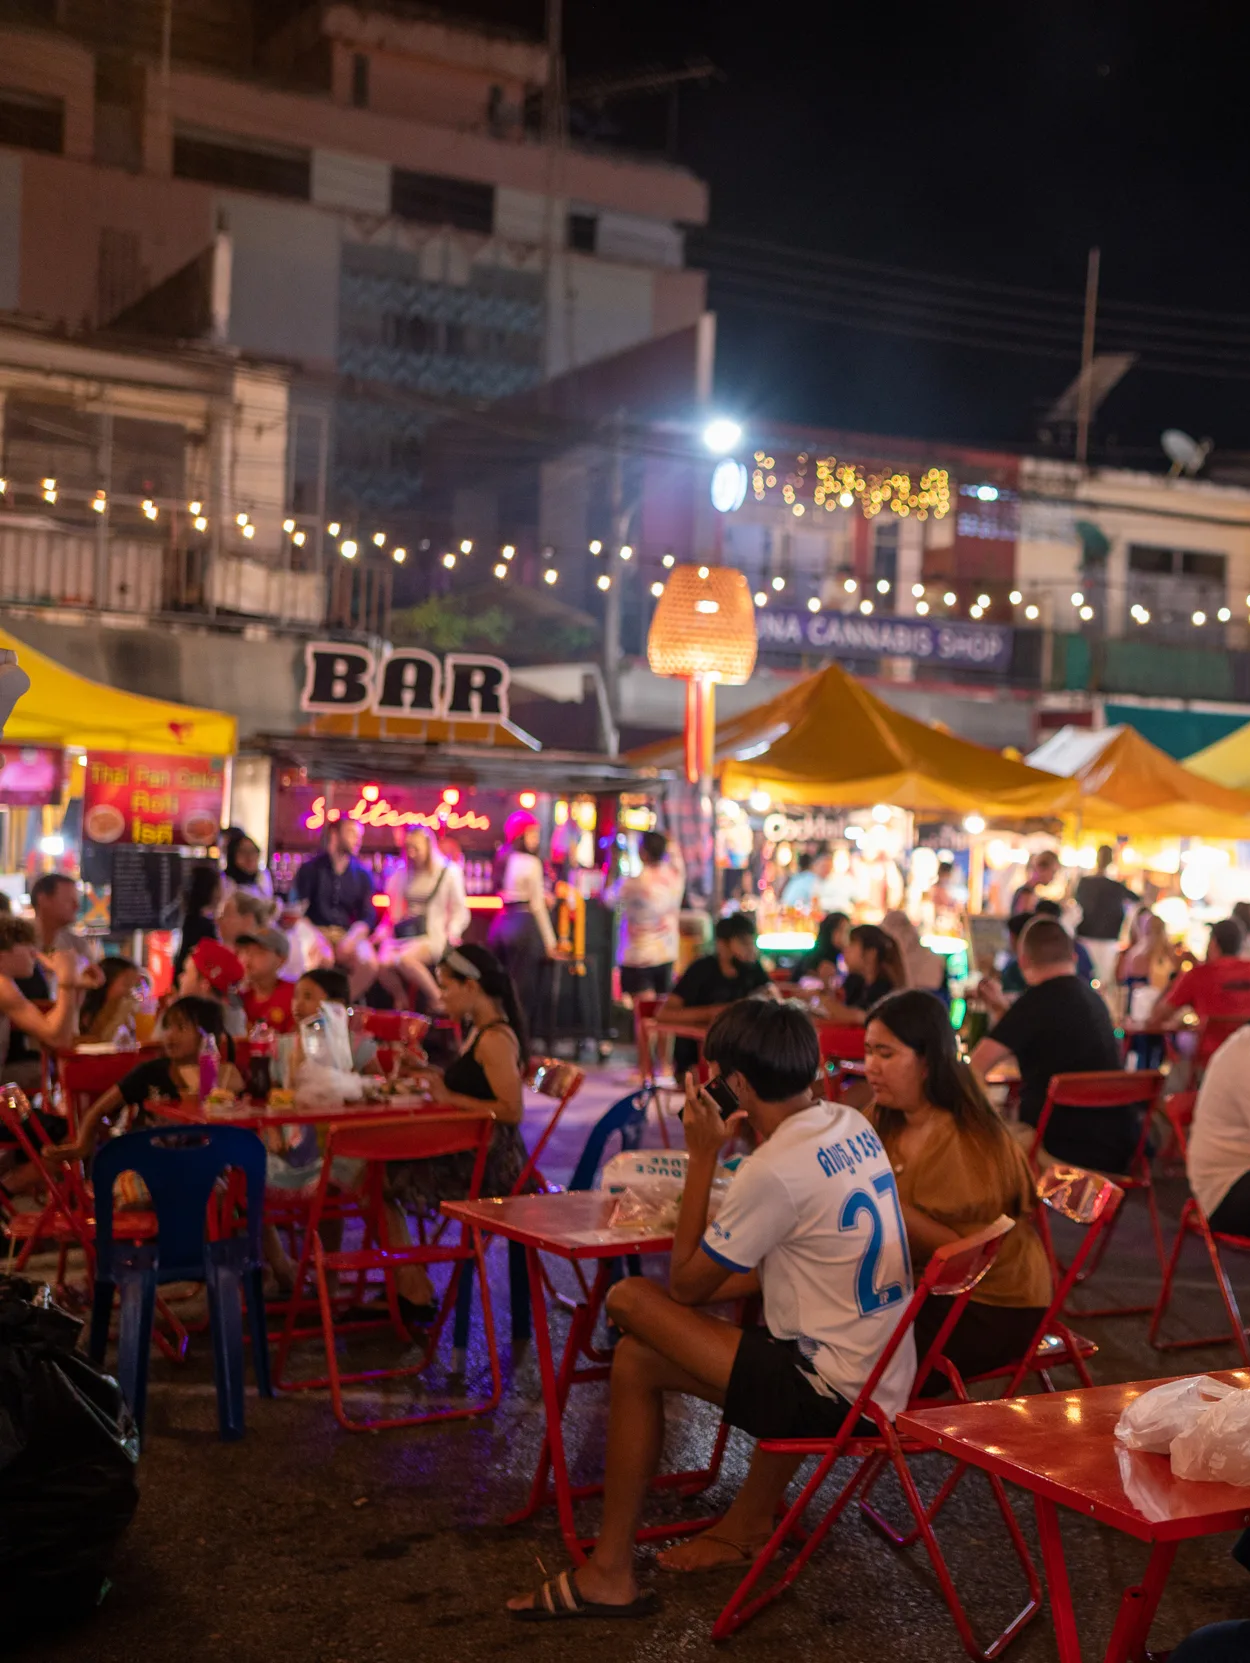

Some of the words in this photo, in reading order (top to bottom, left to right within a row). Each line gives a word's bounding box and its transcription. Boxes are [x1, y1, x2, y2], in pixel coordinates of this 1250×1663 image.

[808, 614, 933, 656] CANNABIS
[938, 627, 1003, 661] SHOP
[304, 645, 508, 720] BAR
[91, 761, 129, 786] Thai
[636, 1163, 686, 1178] DUCE
[651, 1156, 686, 1168] USE
[839, 1168, 913, 1318] 27
